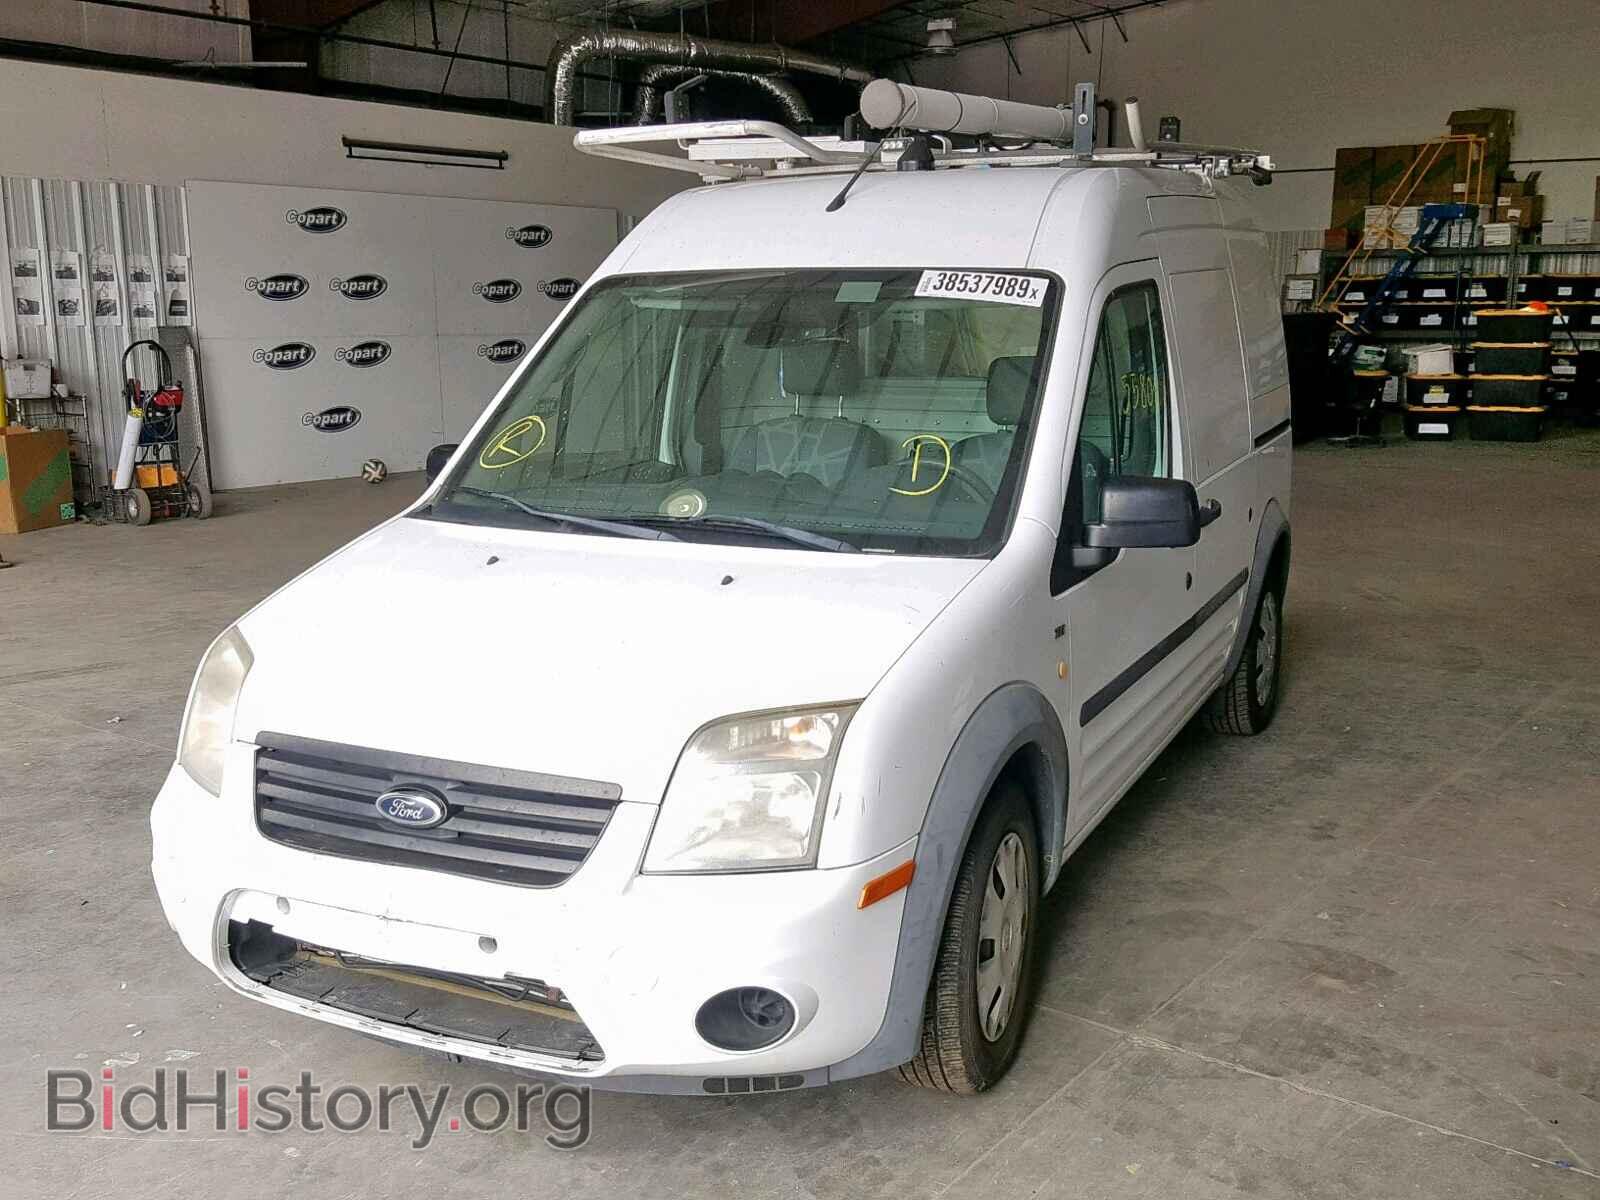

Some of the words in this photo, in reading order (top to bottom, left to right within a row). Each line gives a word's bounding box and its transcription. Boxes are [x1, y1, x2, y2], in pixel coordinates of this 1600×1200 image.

[286, 208, 339, 227] Copart
[505, 227, 547, 241] Copart
[245, 276, 300, 294] Copart
[329, 277, 380, 294] Copart
[472, 282, 516, 296] Copart
[537, 280, 576, 294] Copart
[252, 347, 307, 364] Copart
[335, 345, 384, 362] Copart
[478, 344, 520, 358] Copart
[302, 410, 352, 427] Copart
[388, 798, 425, 820] Ford
